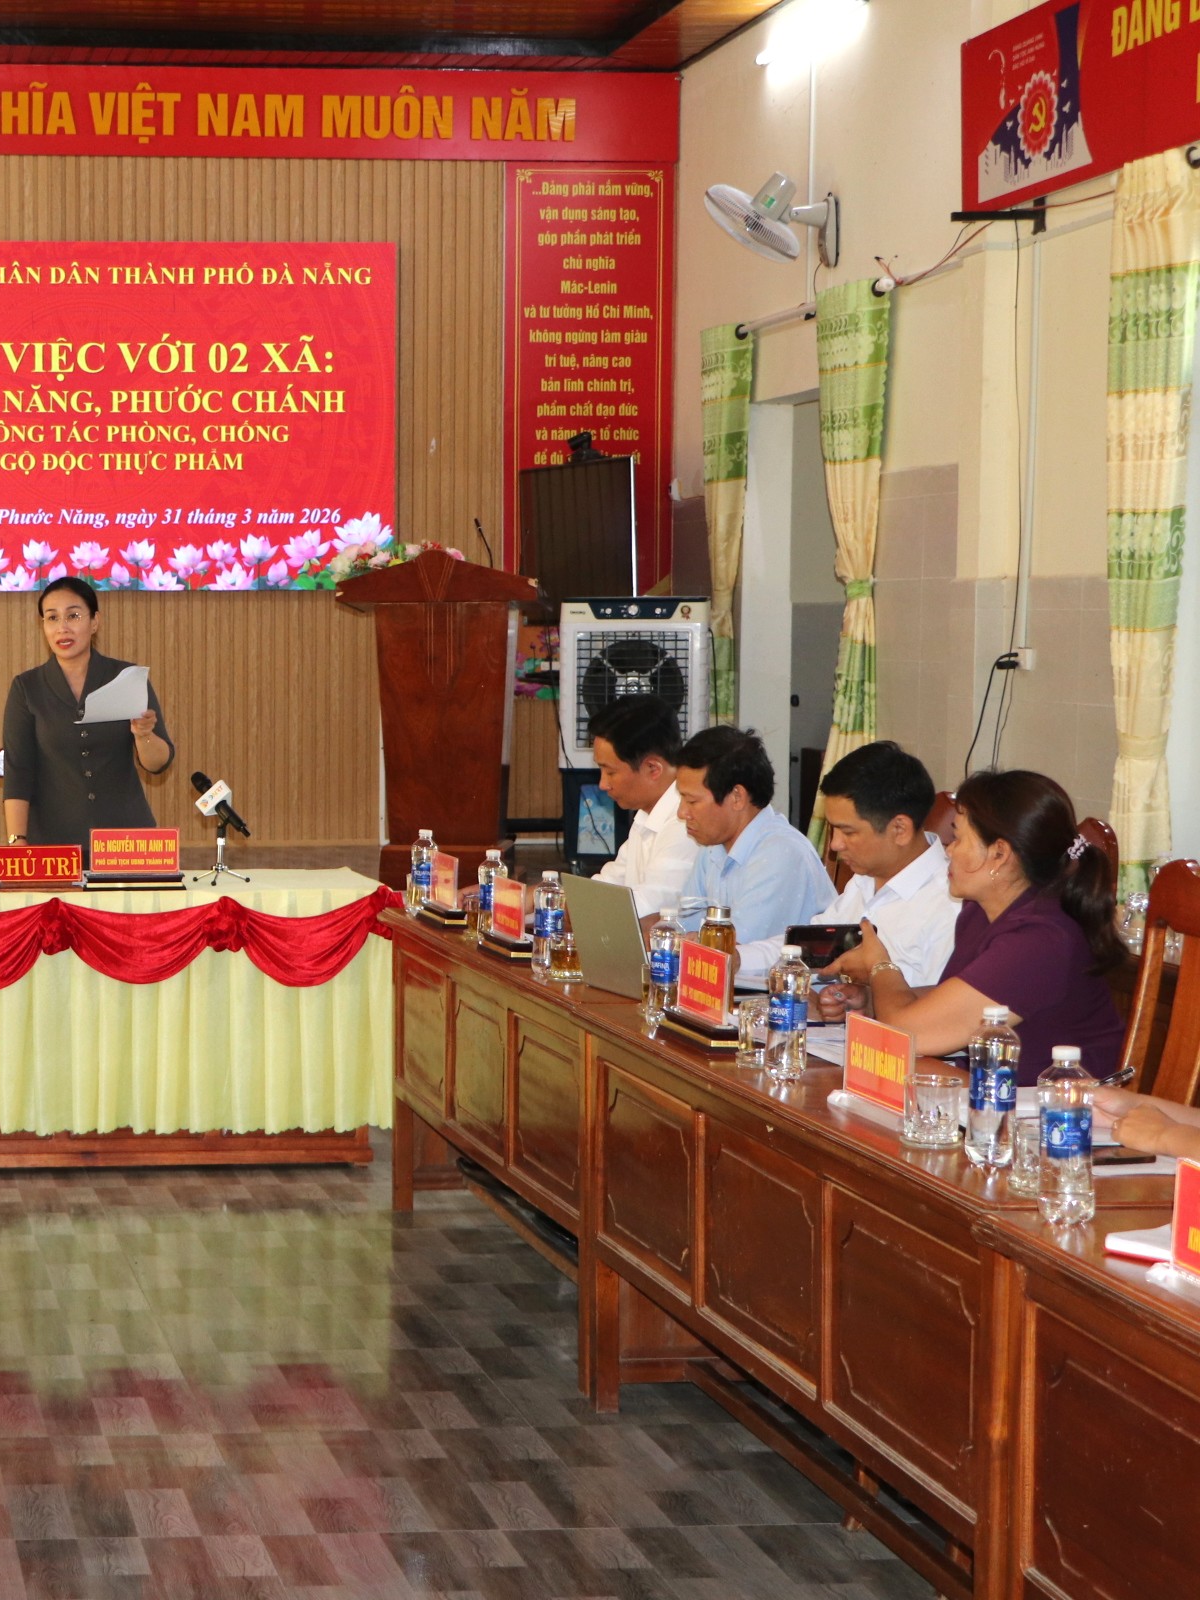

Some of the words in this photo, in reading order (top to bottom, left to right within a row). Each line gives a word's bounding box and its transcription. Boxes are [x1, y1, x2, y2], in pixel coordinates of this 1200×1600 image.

[88, 82, 182, 144] VIỆT
[197, 93, 304, 138] NAM
[321, 86, 454, 140] MUÔN
[471, 88, 577, 142] NĂM
[572, 181, 595, 196] phải
[599, 179, 622, 196] nắm
[625, 182, 654, 198] vững,
[540, 206, 558, 222] vận
[562, 206, 588, 223] dụng
[590, 208, 616, 222] sáng
[620, 207, 640, 223] tạo,
[538, 231, 558, 247] góp
[560, 229, 586, 246] phần
[590, 231, 614, 246] phát
[616, 229, 640, 245] triển
[562, 255, 582, 270] chủ
[586, 256, 616, 272] nghĩa
[50, 261, 100, 285] DÂN
[112, 262, 194, 285] THÀNH
[203, 262, 254, 285] PHỐ
[262, 262, 295, 285] ĐÀ
[302, 262, 372, 285] NẴNG
[560, 279, 618, 295] Mác-Lenin
[524, 304, 536, 318] và
[540, 305, 550, 319] tư
[552, 305, 582, 320] tưởng
[586, 303, 600, 319] Hồ
[602, 305, 620, 319] Chí
[624, 305, 652, 320] Minh,
[530, 329, 562, 345] không
[566, 331, 598, 345] ngừng
[602, 329, 620, 343] làm
[624, 329, 648, 345] giàu
[0, 337, 106, 382] VIỆC
[116, 333, 196, 374] VỚI
[208, 342, 249, 374] 02
[260, 334, 333, 374] XÃ:
[544, 353, 556, 368] trí
[560, 353, 580, 371] tuệ,
[582, 353, 608, 369] nâng
[612, 356, 632, 368] cao
[540, 376, 560, 392] bản
[564, 378, 584, 392] lĩnh
[586, 378, 616, 392] chính
[620, 378, 634, 395] trị,
[2, 384, 102, 417] NĂNG,
[110, 384, 223, 413] PHƯỚC
[231, 384, 346, 413] CHÁNH
[536, 400, 566, 418] phẩm
[570, 400, 592, 417] chất
[596, 403, 616, 418] đạo
[618, 402, 638, 417] đức
[50, 420, 100, 443] TÁC
[107, 420, 197, 445] PHÒNG,
[202, 420, 289, 443] CHỐNG
[535, 427, 548, 440] và
[600, 424, 611, 441] tổ
[613, 426, 639, 441] chức
[42, 450, 93, 476] ĐỘC
[98, 450, 167, 475] THỰC
[174, 451, 243, 471] PHẨM
[534, 449, 547, 465] để
[551, 450, 564, 465] đủ
[57, 508, 110, 529] Năng,
[115, 508, 158, 529] ngày
[161, 508, 182, 525] 31
[187, 508, 238, 528] tháng
[241, 508, 253, 525] 3
[256, 508, 295, 524] năm
[300, 508, 341, 525] 2026
[94, 839, 105, 853] Đ/c
[107, 835, 135, 852] NGUYỄN
[136, 839, 147, 855] THỊ
[149, 839, 163, 852] ANH
[165, 839, 176, 852] THI
[42, 851, 79, 877] TRÌ
